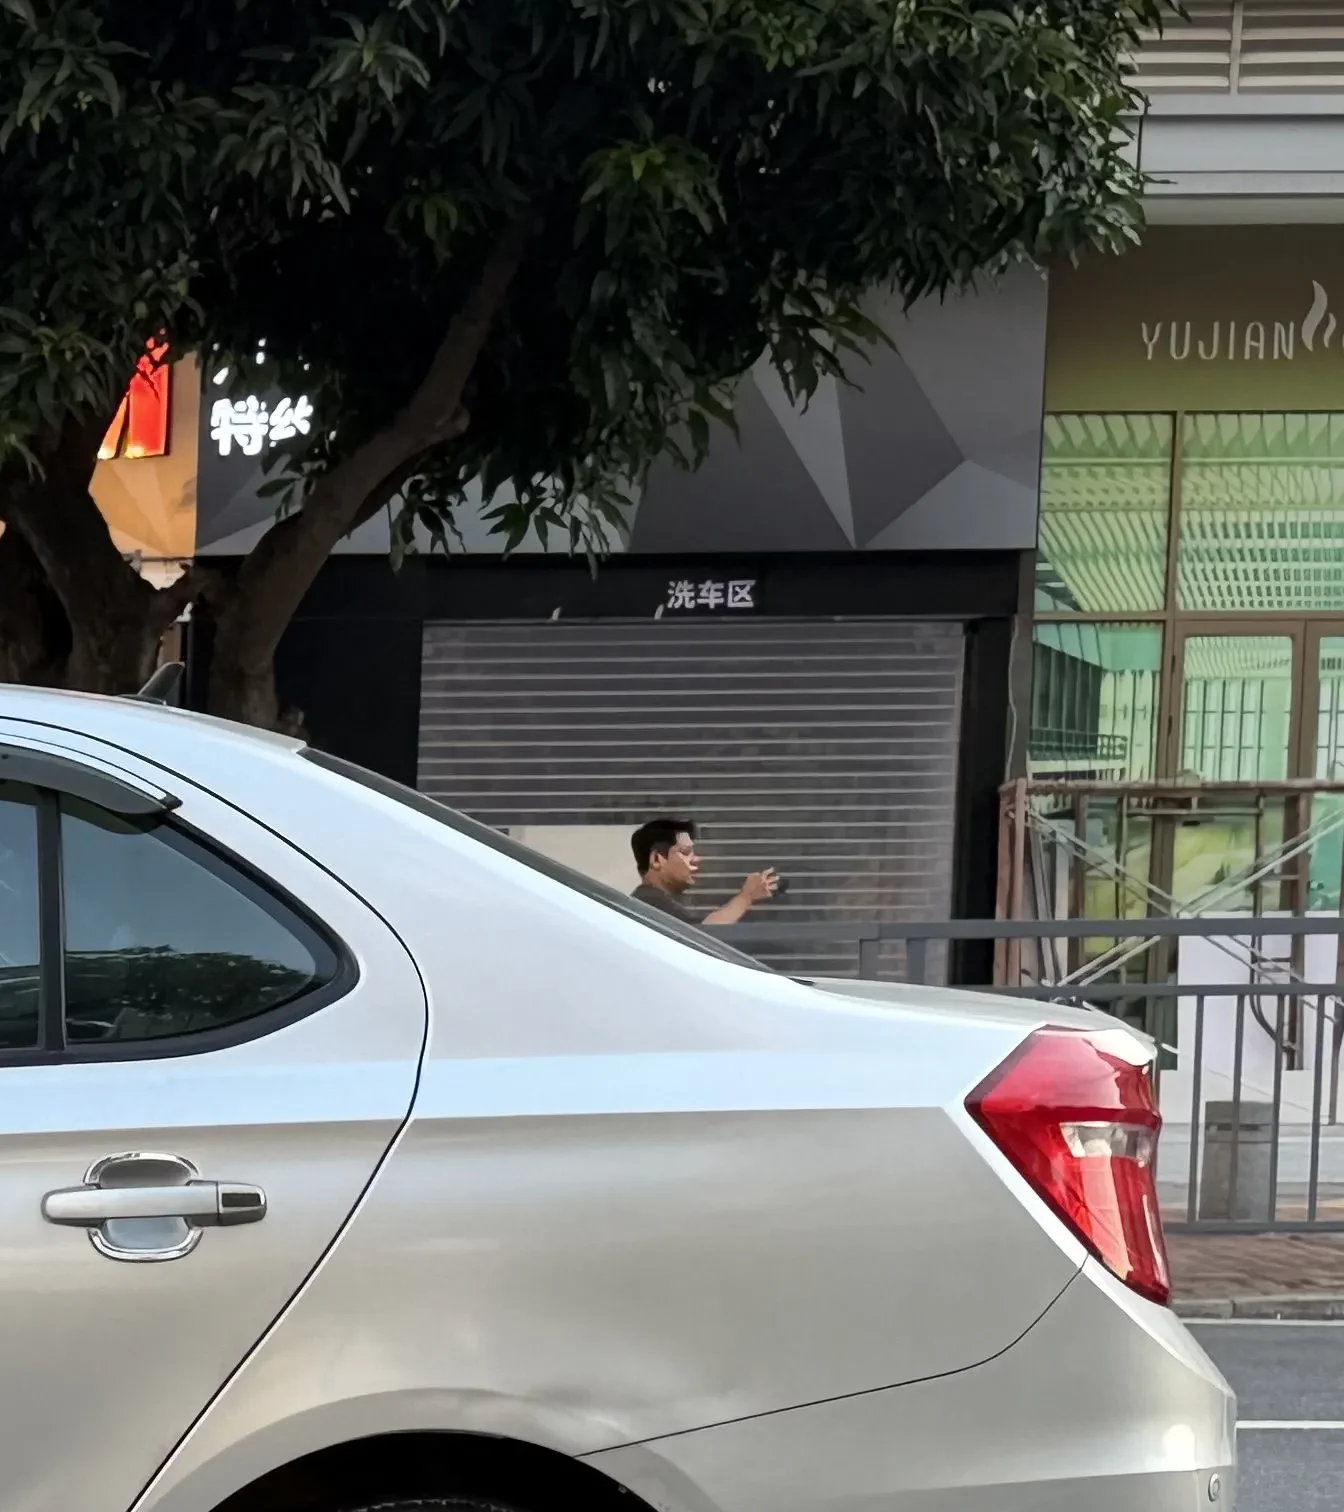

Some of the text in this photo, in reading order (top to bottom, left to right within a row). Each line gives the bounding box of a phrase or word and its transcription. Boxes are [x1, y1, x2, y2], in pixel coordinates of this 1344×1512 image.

[1141, 321, 1295, 361] YUJIAN
[667, 579, 756, 609] 洗车区
